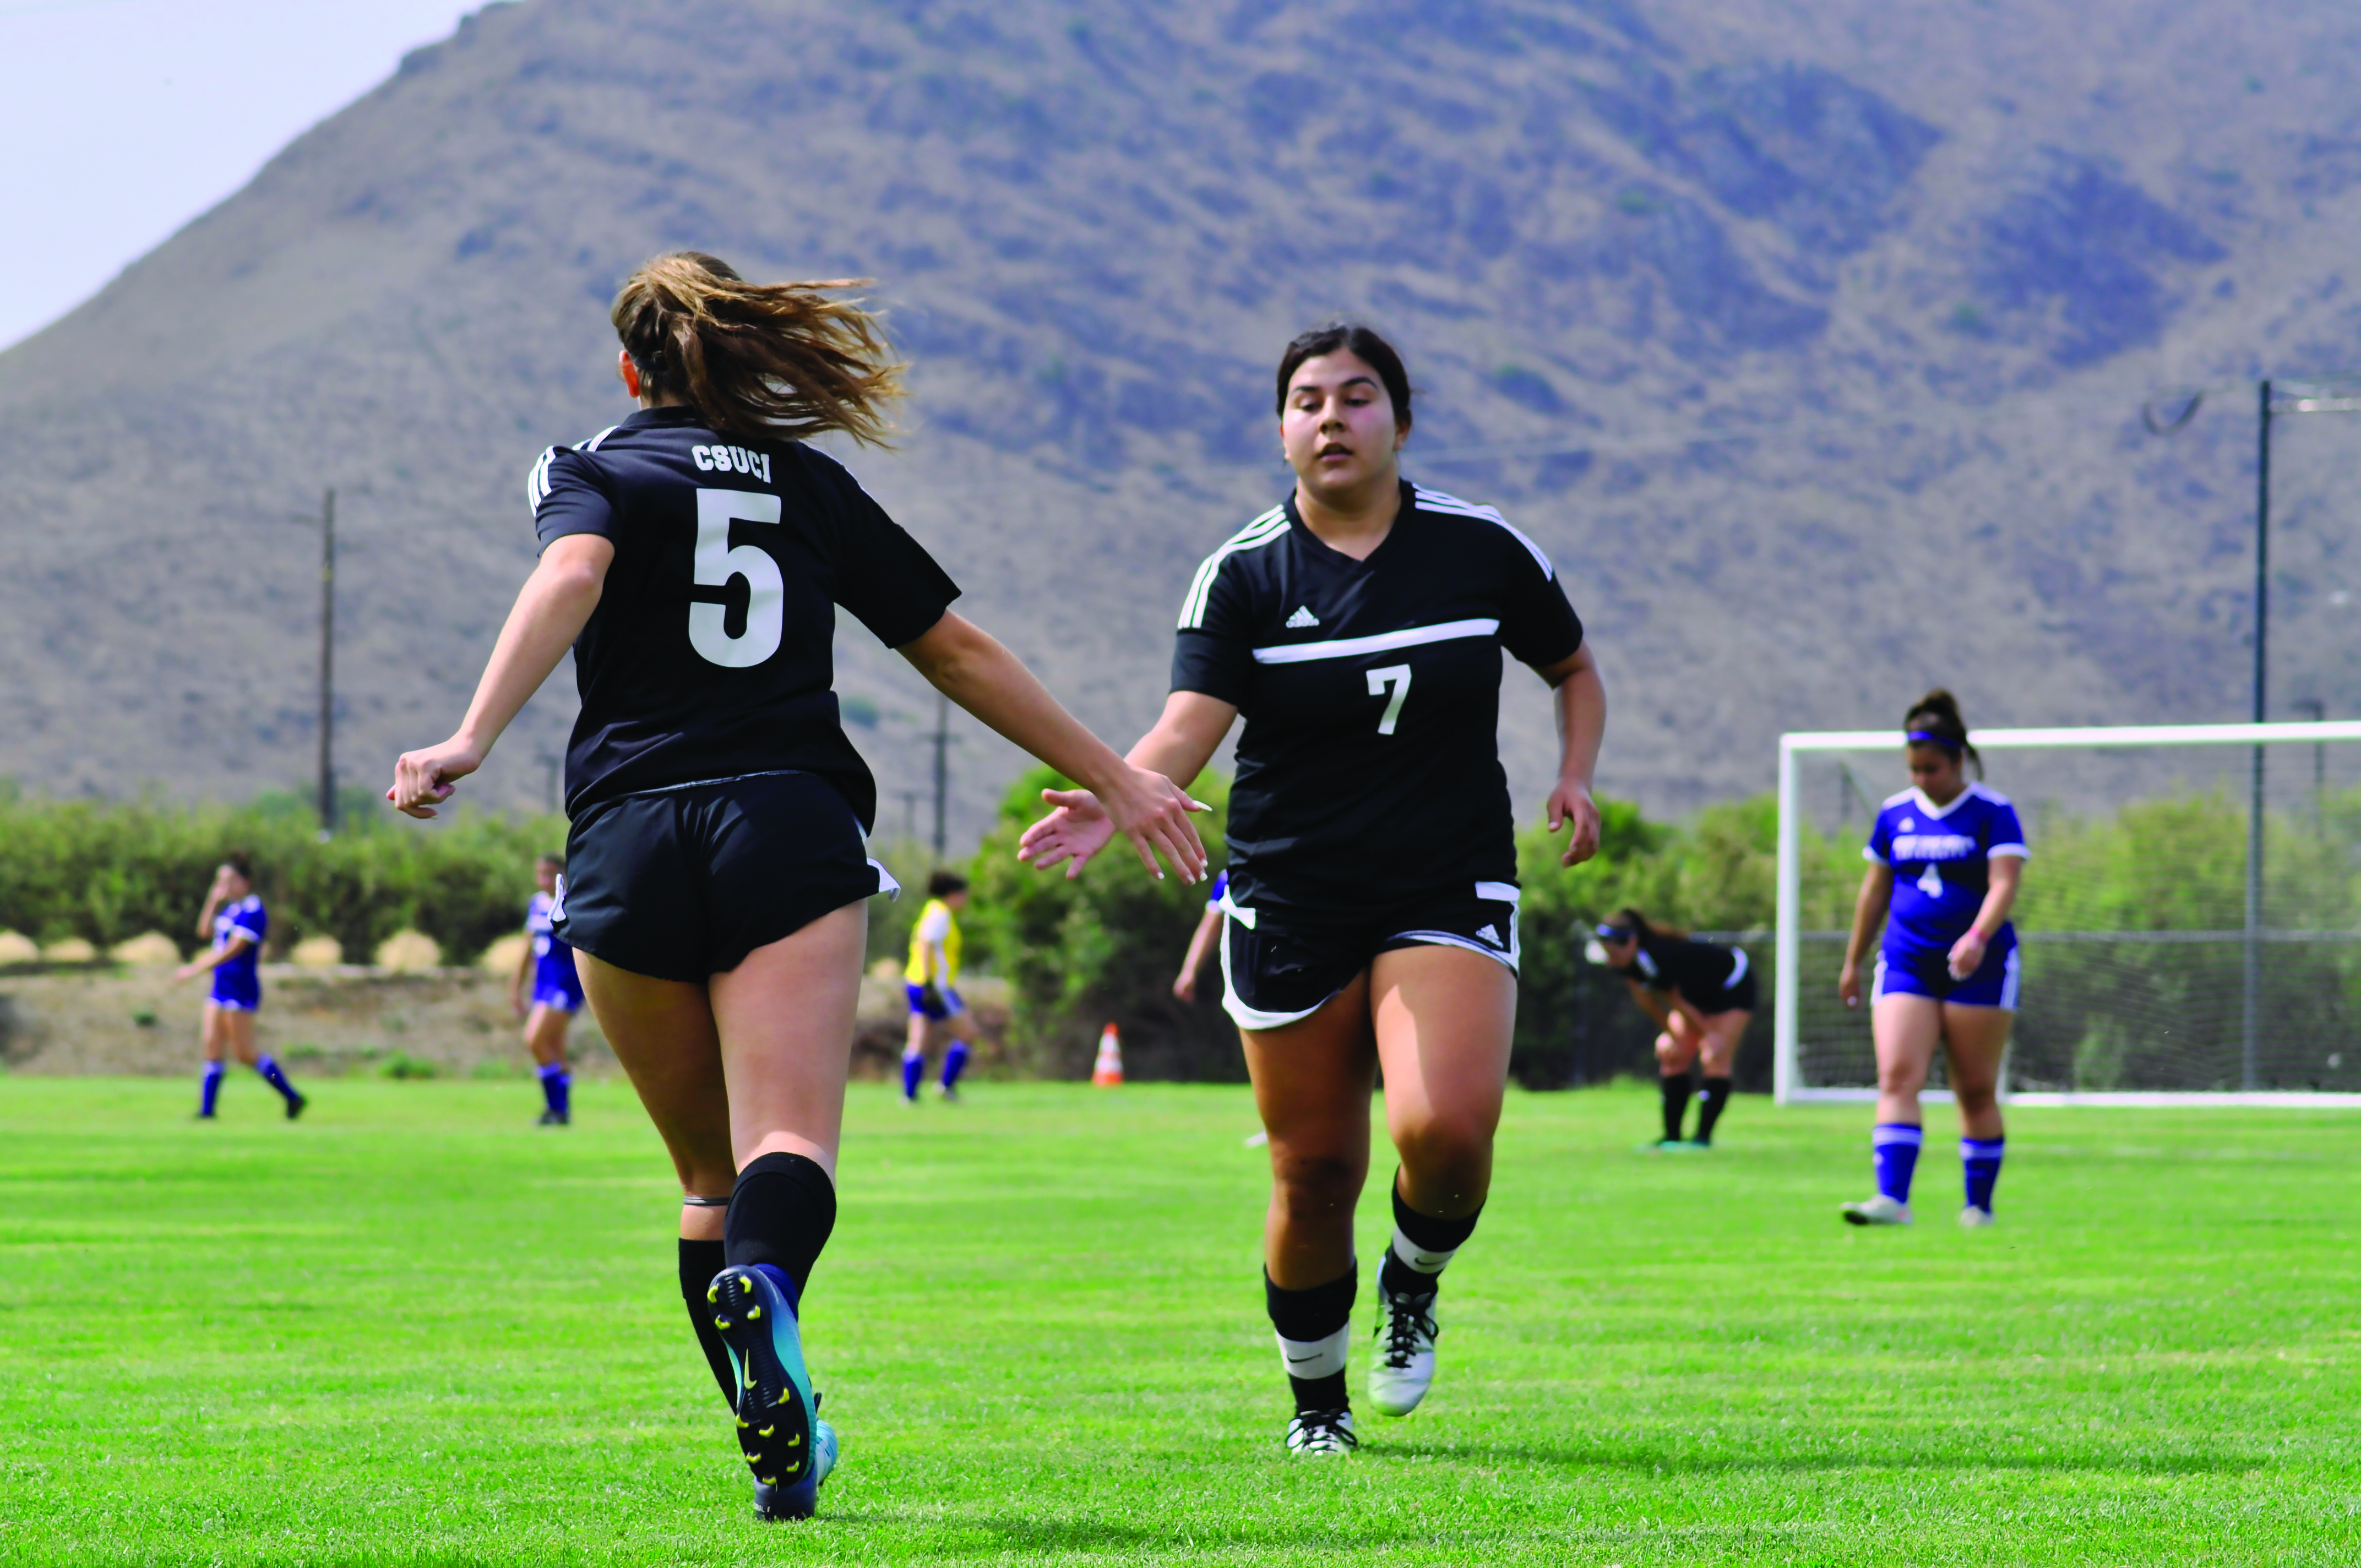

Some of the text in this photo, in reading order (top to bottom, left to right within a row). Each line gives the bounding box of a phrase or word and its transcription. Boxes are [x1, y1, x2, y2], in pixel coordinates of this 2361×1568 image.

[691, 445, 771, 483] CSUCI
[688, 488, 784, 668] 5
[1366, 664, 1412, 735] 7
